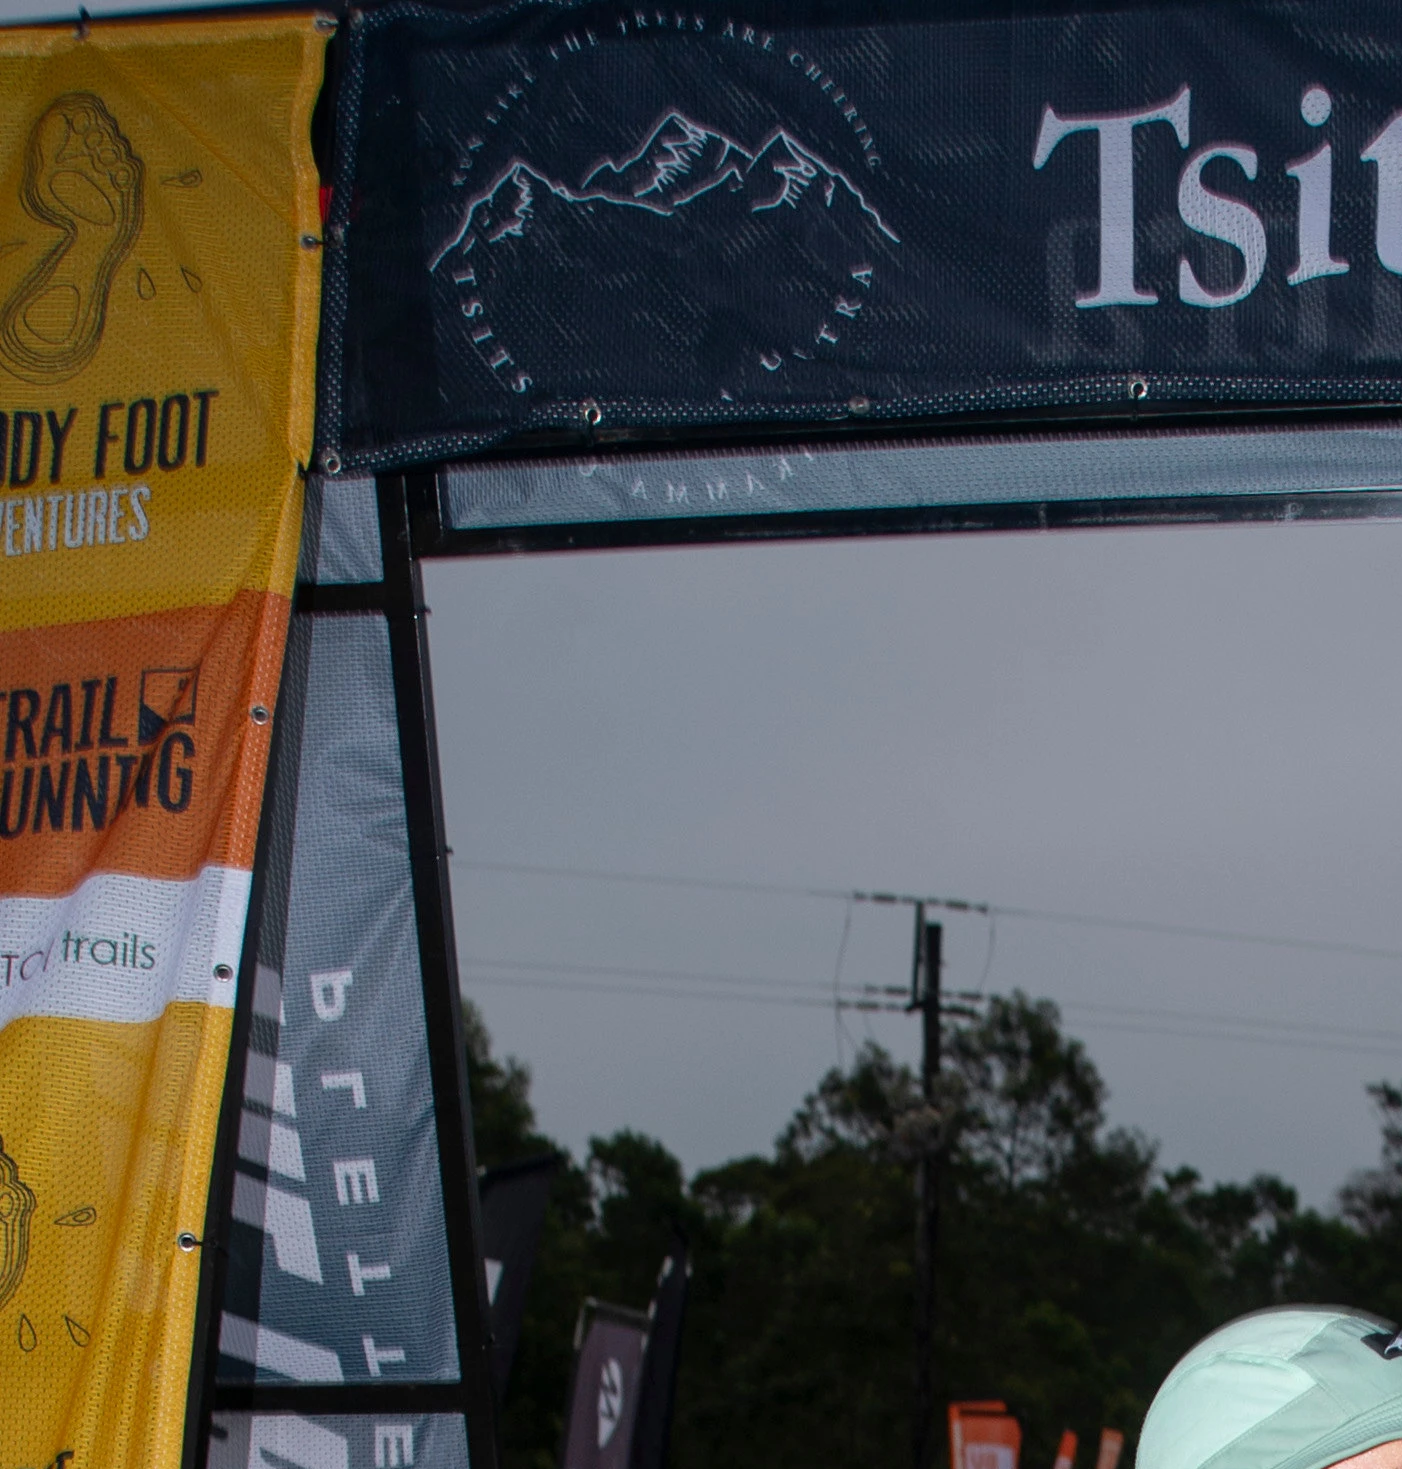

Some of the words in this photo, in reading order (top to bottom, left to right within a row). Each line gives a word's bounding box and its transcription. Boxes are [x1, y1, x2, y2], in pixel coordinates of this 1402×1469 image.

[723, 18, 775, 52] ARE
[0, 406, 79, 490] DY
[94, 387, 221, 480] FOOT
[0, 484, 152, 557] ENTURES
[0, 675, 129, 764] RAIL
[62, 930, 156, 970] trails
